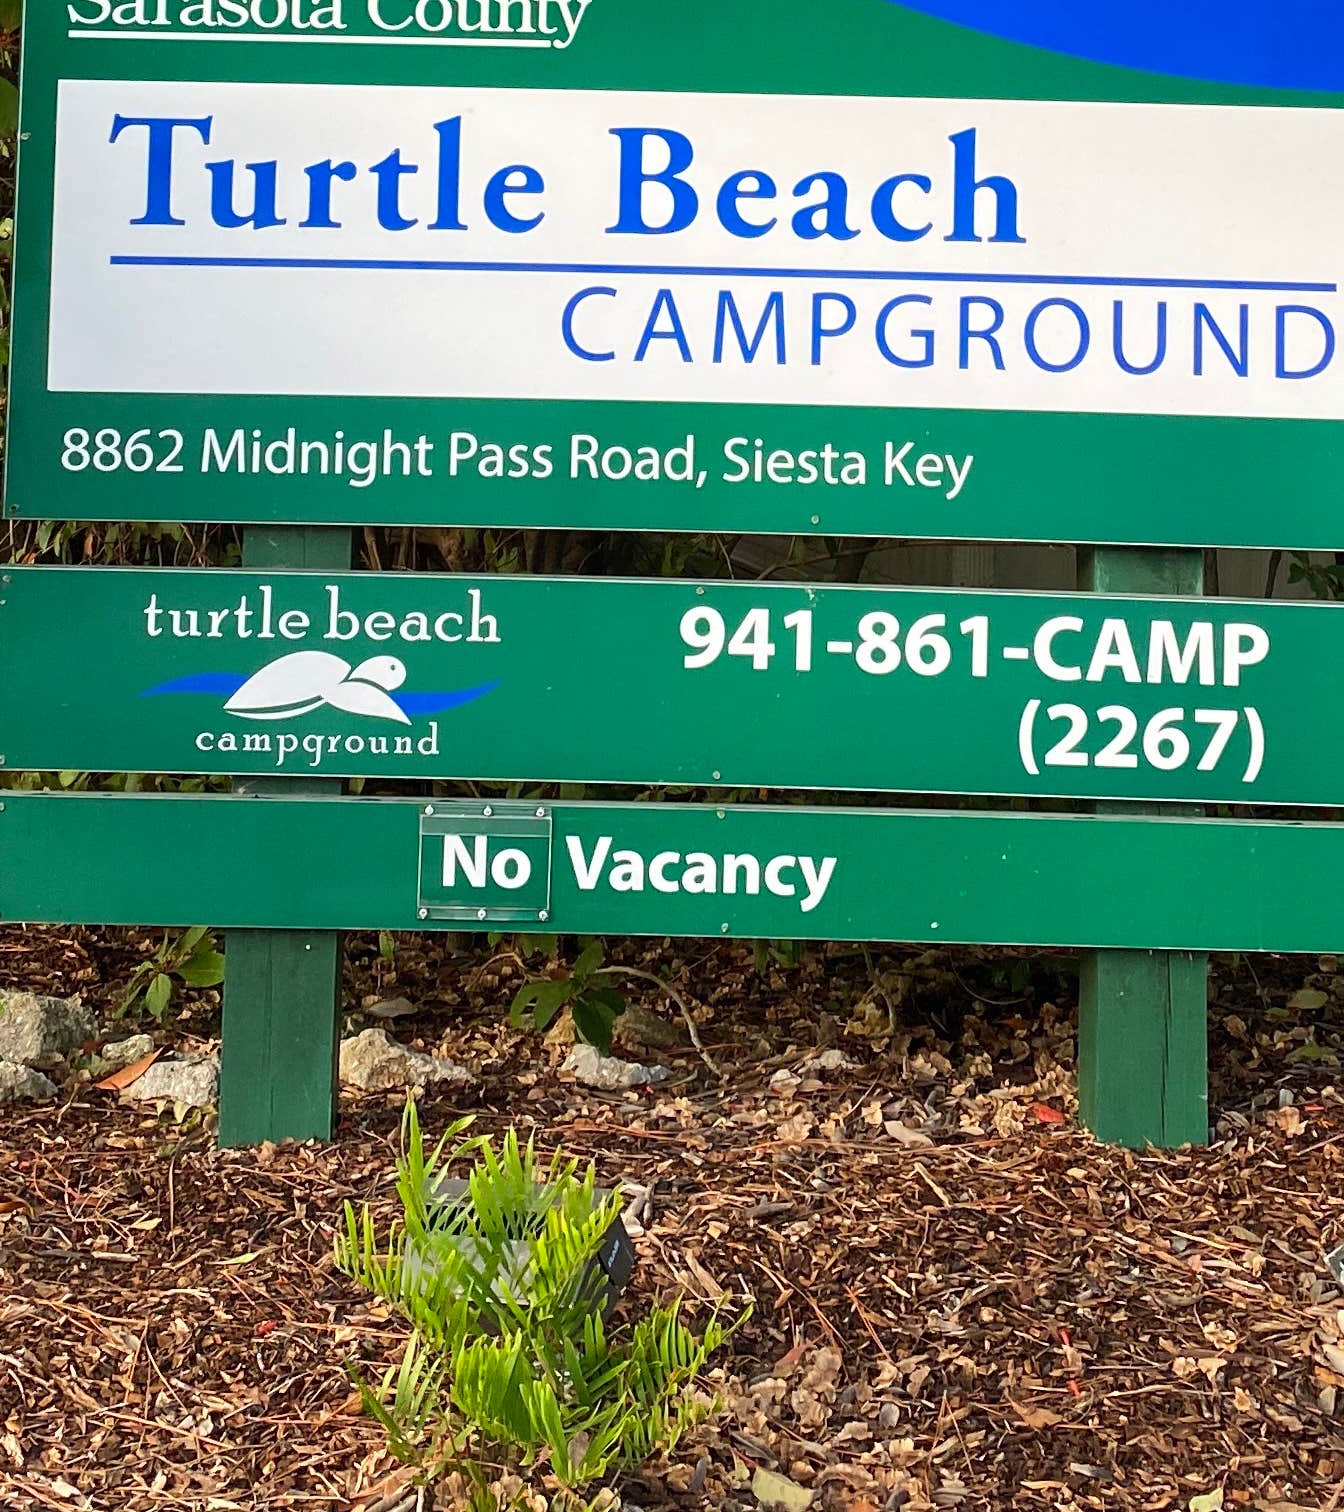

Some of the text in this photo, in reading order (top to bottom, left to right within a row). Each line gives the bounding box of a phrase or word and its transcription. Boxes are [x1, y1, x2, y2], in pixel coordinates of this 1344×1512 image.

[108, 113, 1027, 244] Turtle Beach
[561, 285, 1337, 380] CAMPGROUND
[61, 427, 974, 500] 8862 Midnight Pass Road, Siesta Key
[143, 585, 502, 643] turtle beach
[679, 605, 1270, 687] 941-861-CAMP
[195, 721, 440, 767] campground
[1018, 699, 1265, 783] (2267)
[442, 834, 837, 912] No Vacancy
